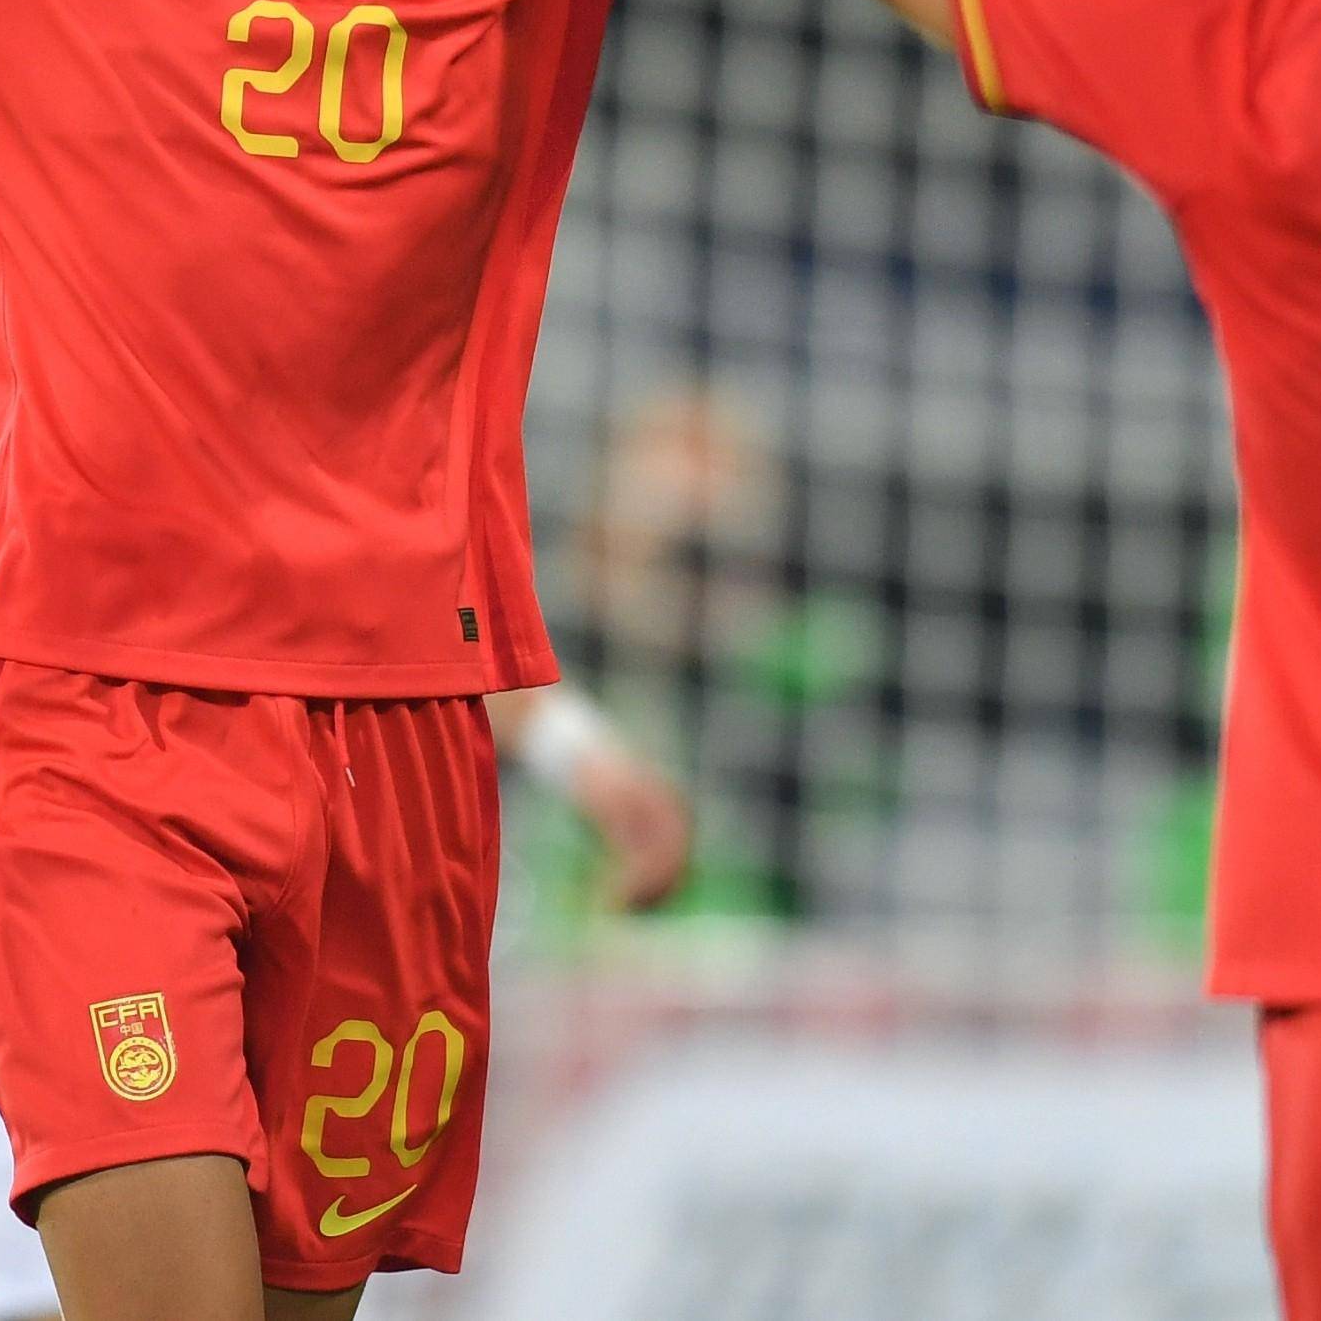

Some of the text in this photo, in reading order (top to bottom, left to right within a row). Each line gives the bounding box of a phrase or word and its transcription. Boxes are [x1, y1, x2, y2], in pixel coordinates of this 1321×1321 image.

[221, 0, 407, 163] 20
[99, 1001, 159, 1027] CFA
[301, 1011, 464, 1177] 20
